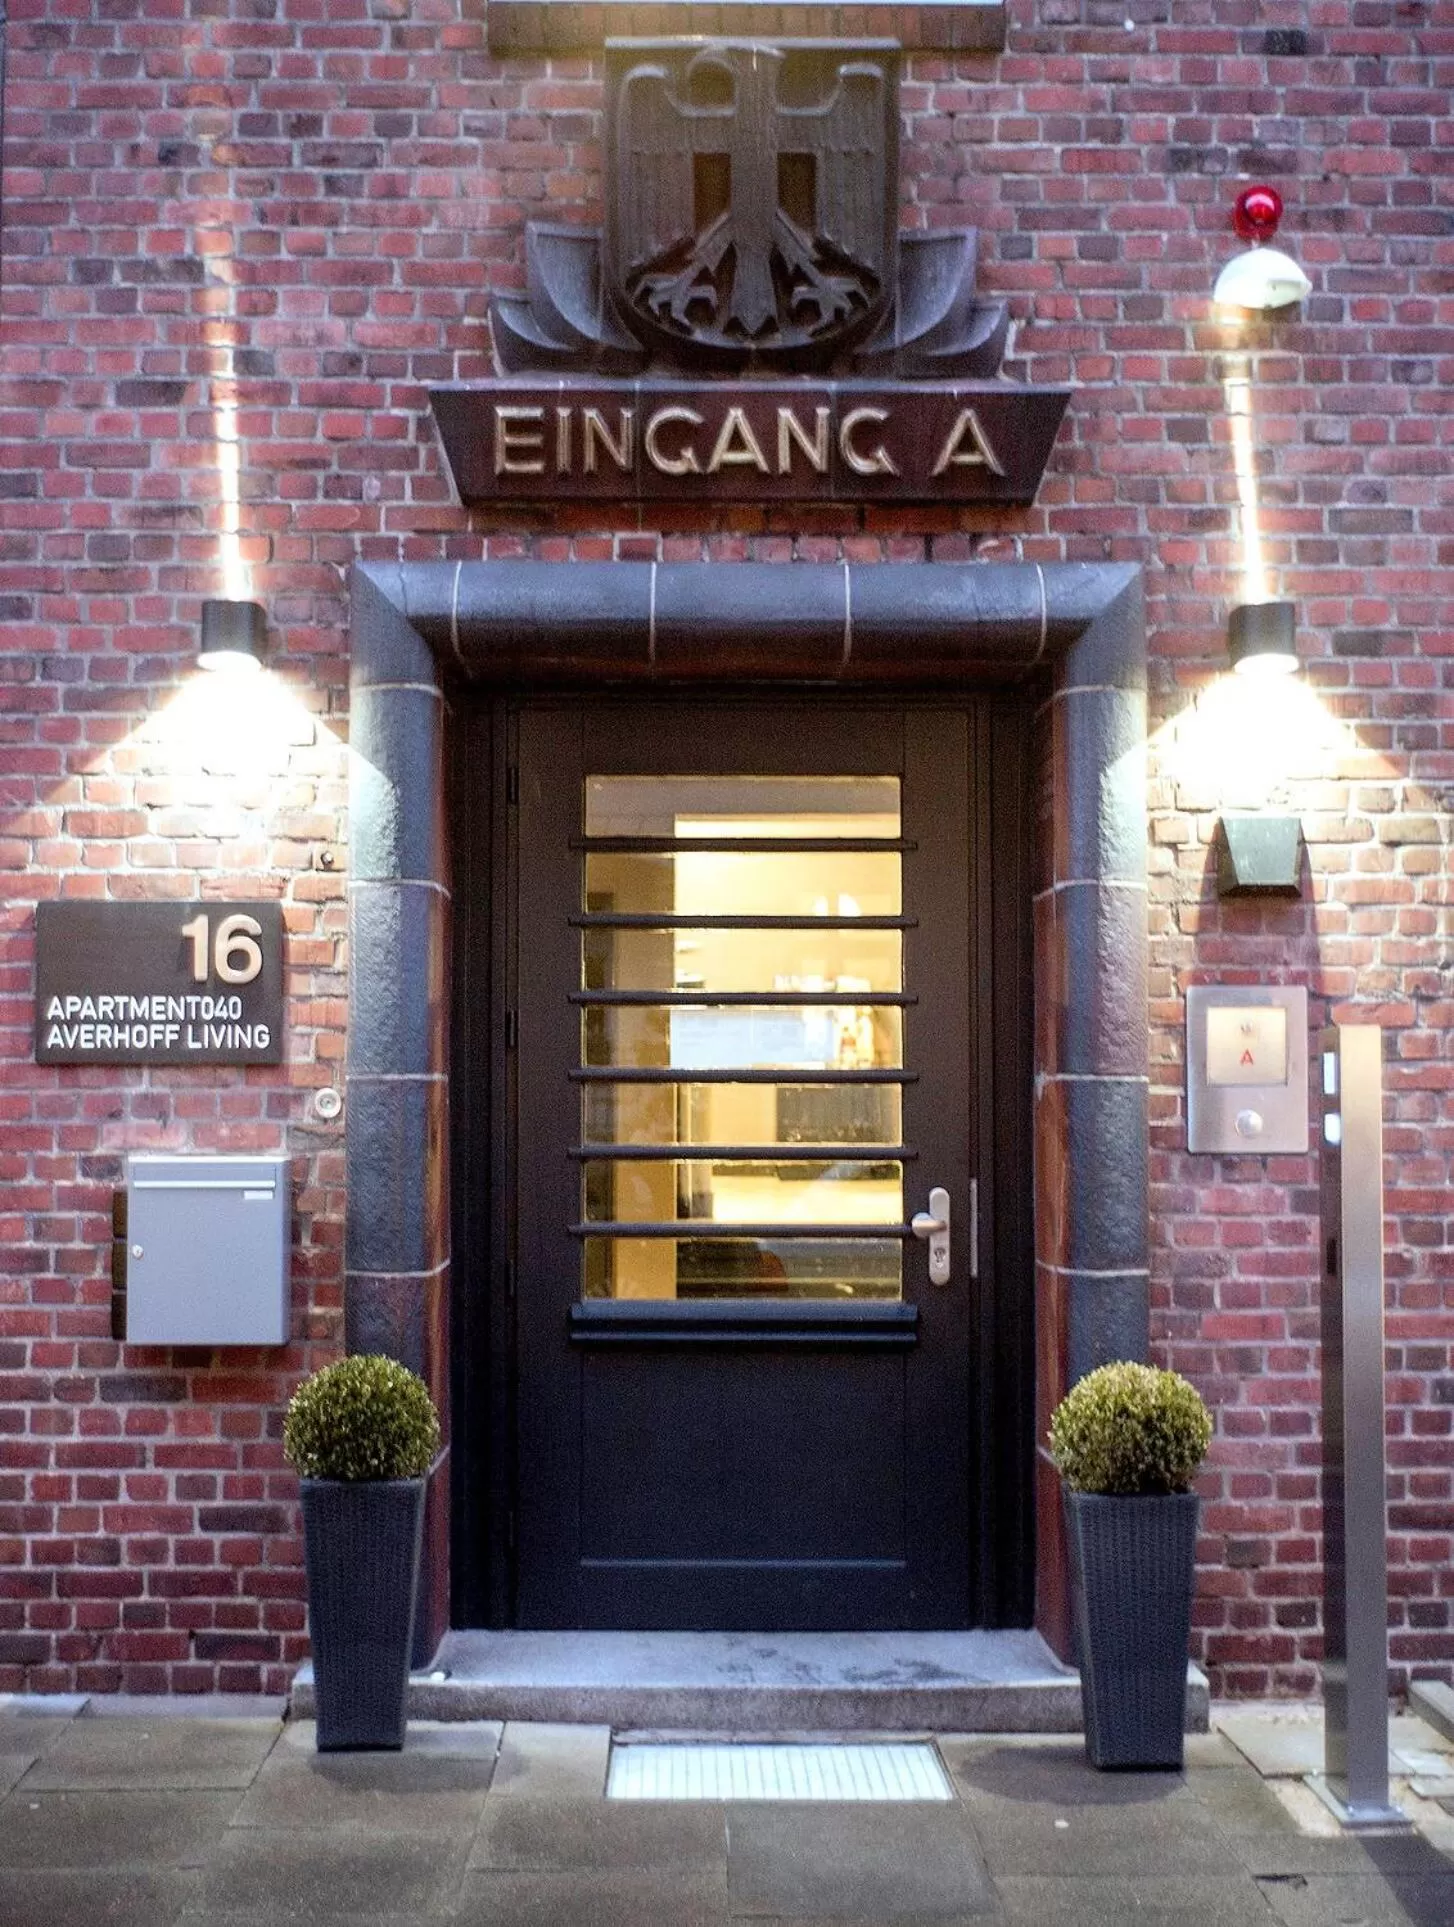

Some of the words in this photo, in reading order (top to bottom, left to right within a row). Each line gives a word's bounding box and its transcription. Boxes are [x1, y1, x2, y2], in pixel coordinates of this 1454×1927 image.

[493, 405, 899, 476] EINGANG
[931, 407, 1005, 476] A
[181, 913, 263, 985] 16
[46, 995, 243, 1020] APARTMENT040
[46, 1023, 180, 1049] AVERHOFF
[187, 1024, 271, 1049] LIVING
[1240, 1049, 1254, 1065] A
